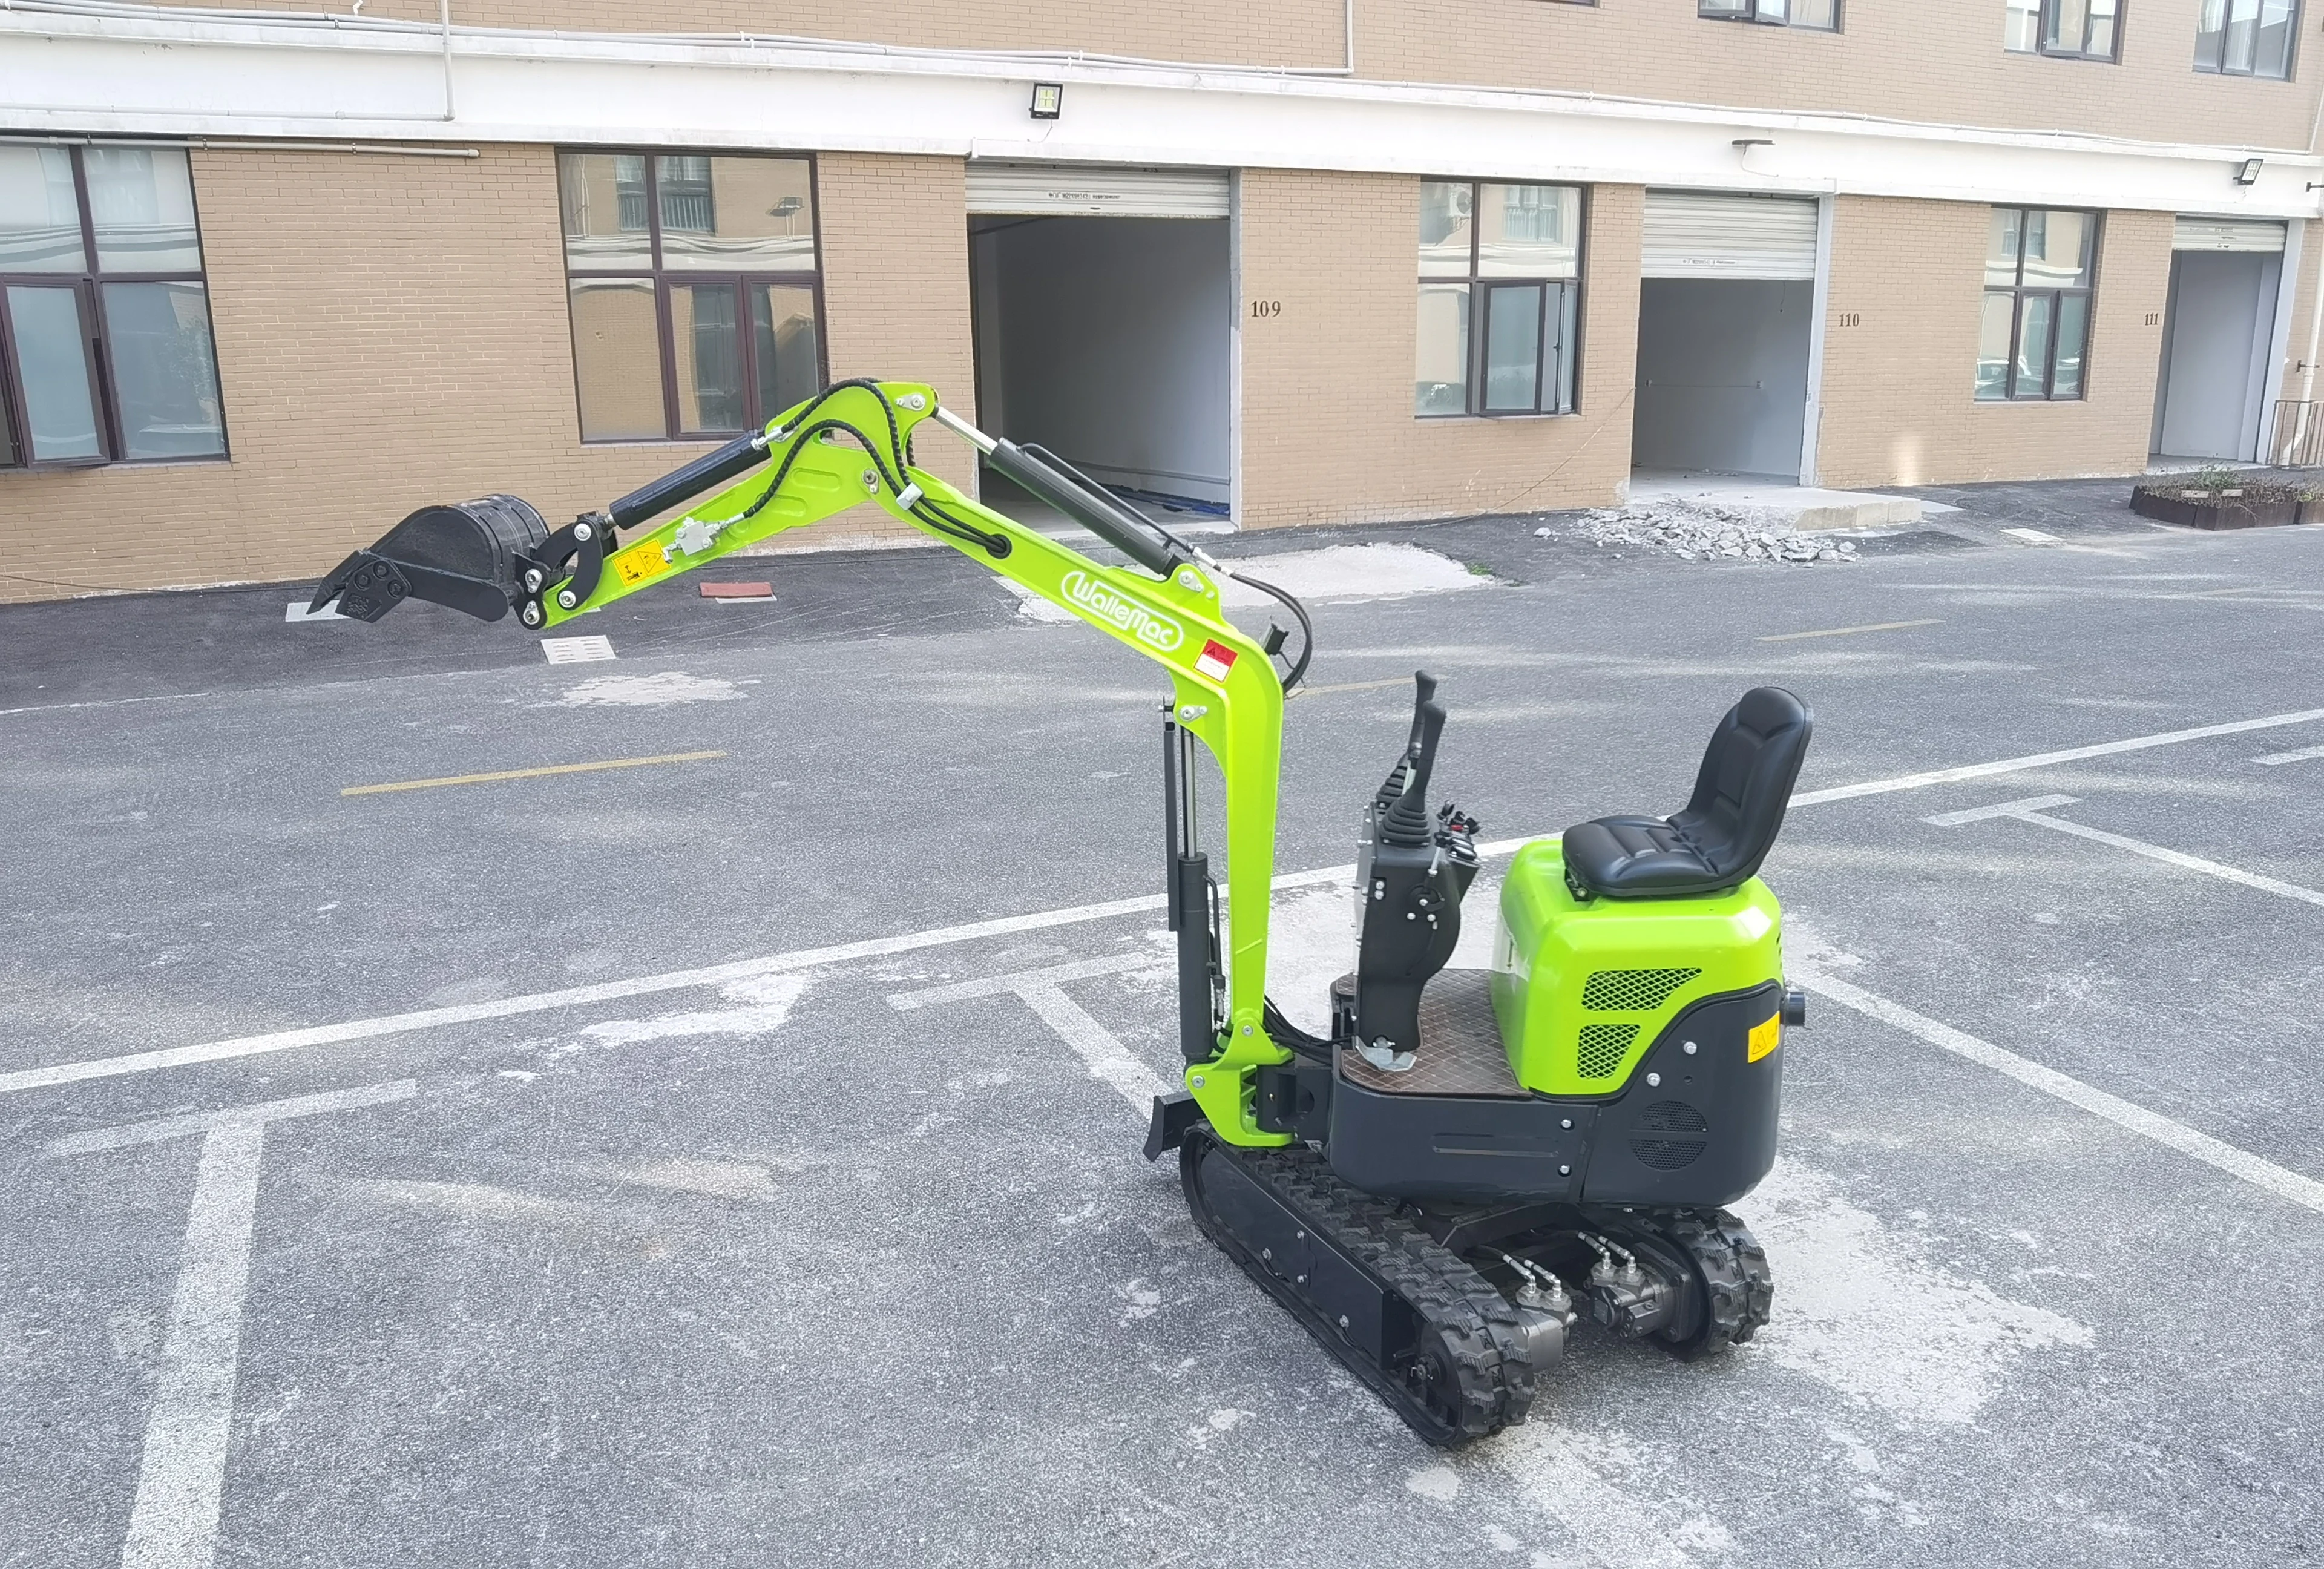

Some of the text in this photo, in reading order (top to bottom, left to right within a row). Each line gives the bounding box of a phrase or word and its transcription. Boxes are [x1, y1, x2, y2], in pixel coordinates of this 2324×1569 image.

[1251, 300, 1281, 318] 109
[1839, 313, 1860, 327] 110
[2144, 312, 2159, 326] 111
[1066, 571, 1179, 647] WalleMac
